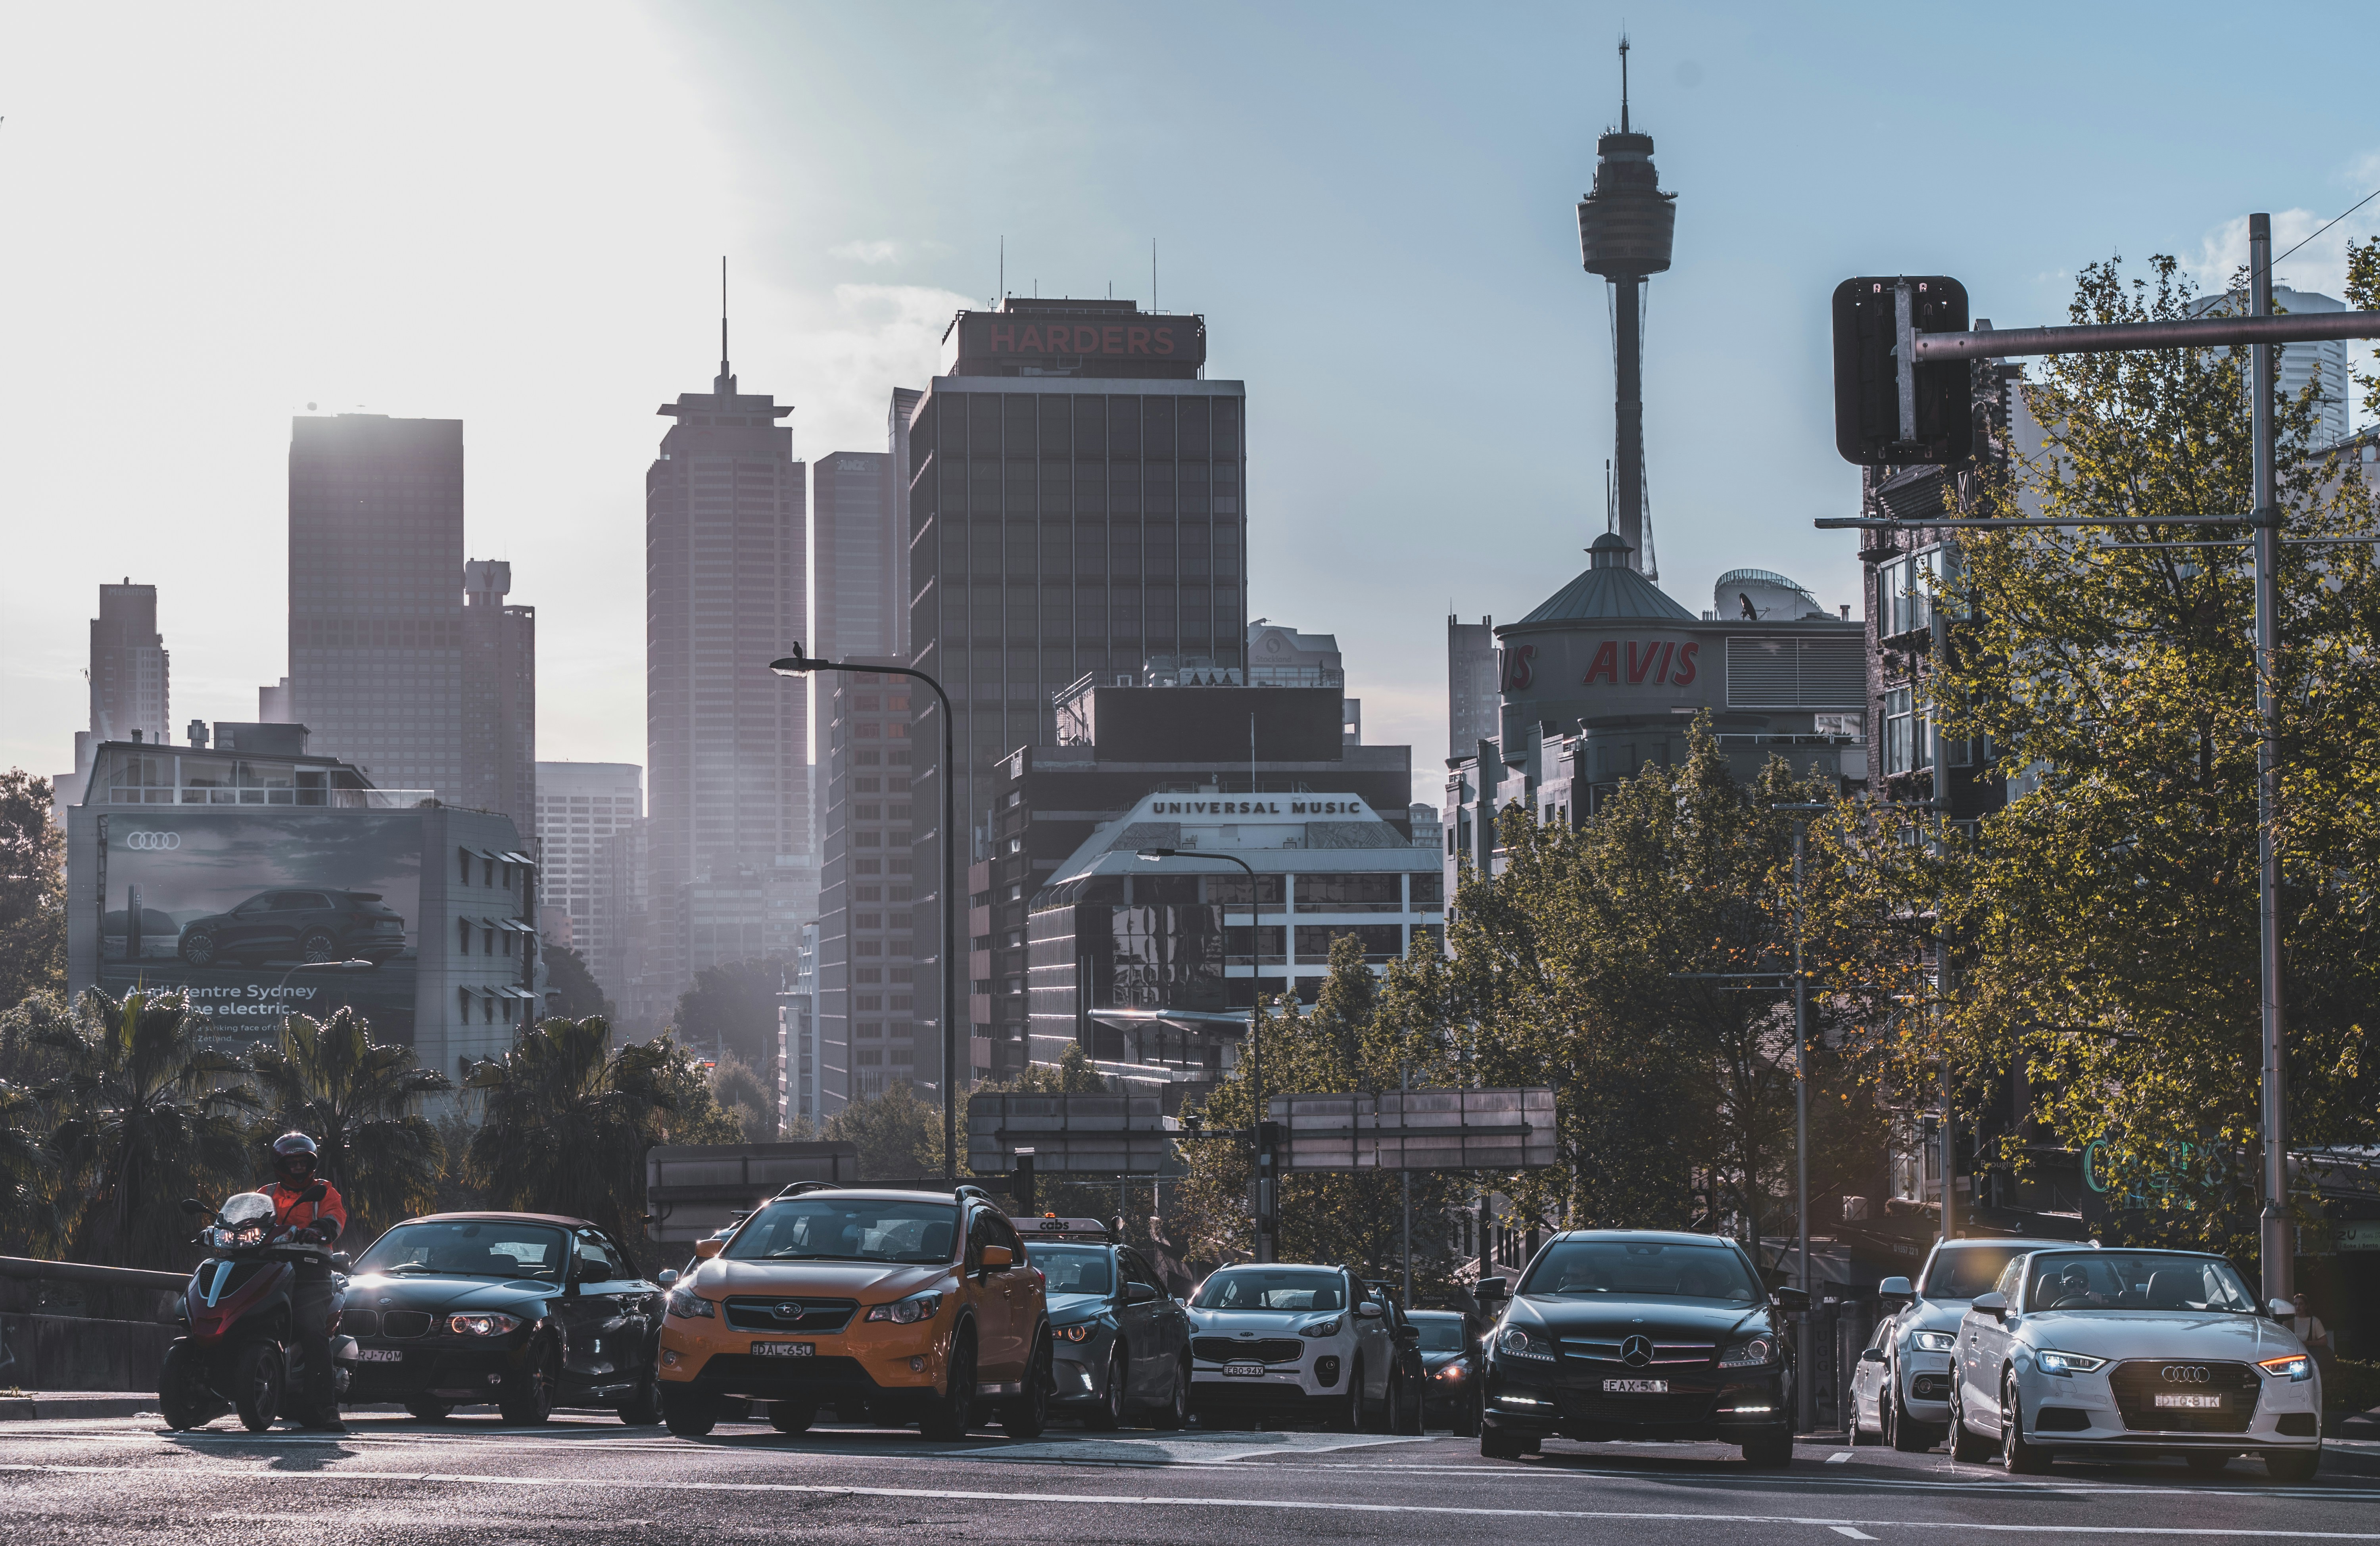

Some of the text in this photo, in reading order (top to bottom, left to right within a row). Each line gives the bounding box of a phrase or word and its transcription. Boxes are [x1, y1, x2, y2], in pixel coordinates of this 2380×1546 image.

[991, 324, 1175, 355] HARDERS
[1582, 640, 1700, 686] AVIS
[1154, 802, 1360, 814] UNIVERSAL MUSIC
[247, 984, 317, 1000] Sydney
[219, 1002, 294, 1015] electric.
[1040, 1219, 1069, 1230] cabs
